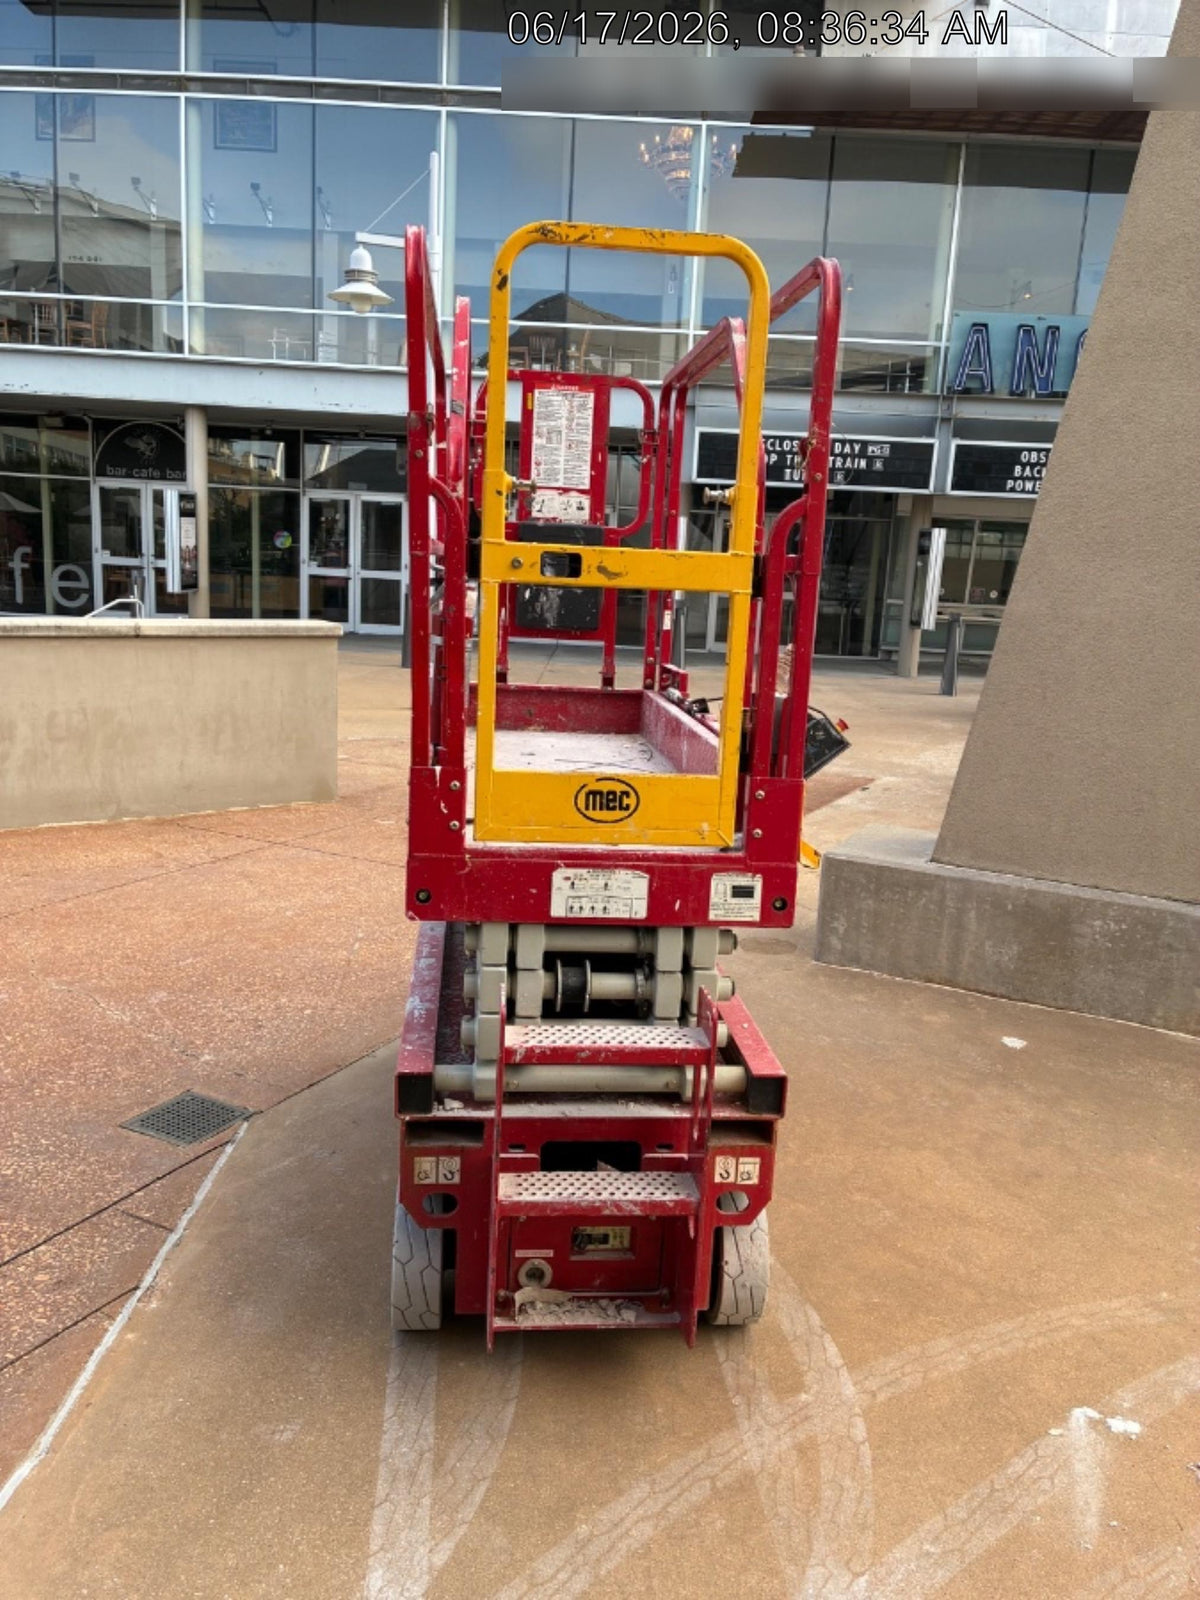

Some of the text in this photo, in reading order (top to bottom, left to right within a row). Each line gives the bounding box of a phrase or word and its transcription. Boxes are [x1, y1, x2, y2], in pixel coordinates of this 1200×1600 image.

[834, 442, 861, 455] DAY
[829, 456, 867, 470] TRAIN
[1020, 450, 1048, 463] OBS
[784, 468, 806, 481] TU
[1006, 479, 1043, 492] POWE
[584, 789, 631, 812] mec
